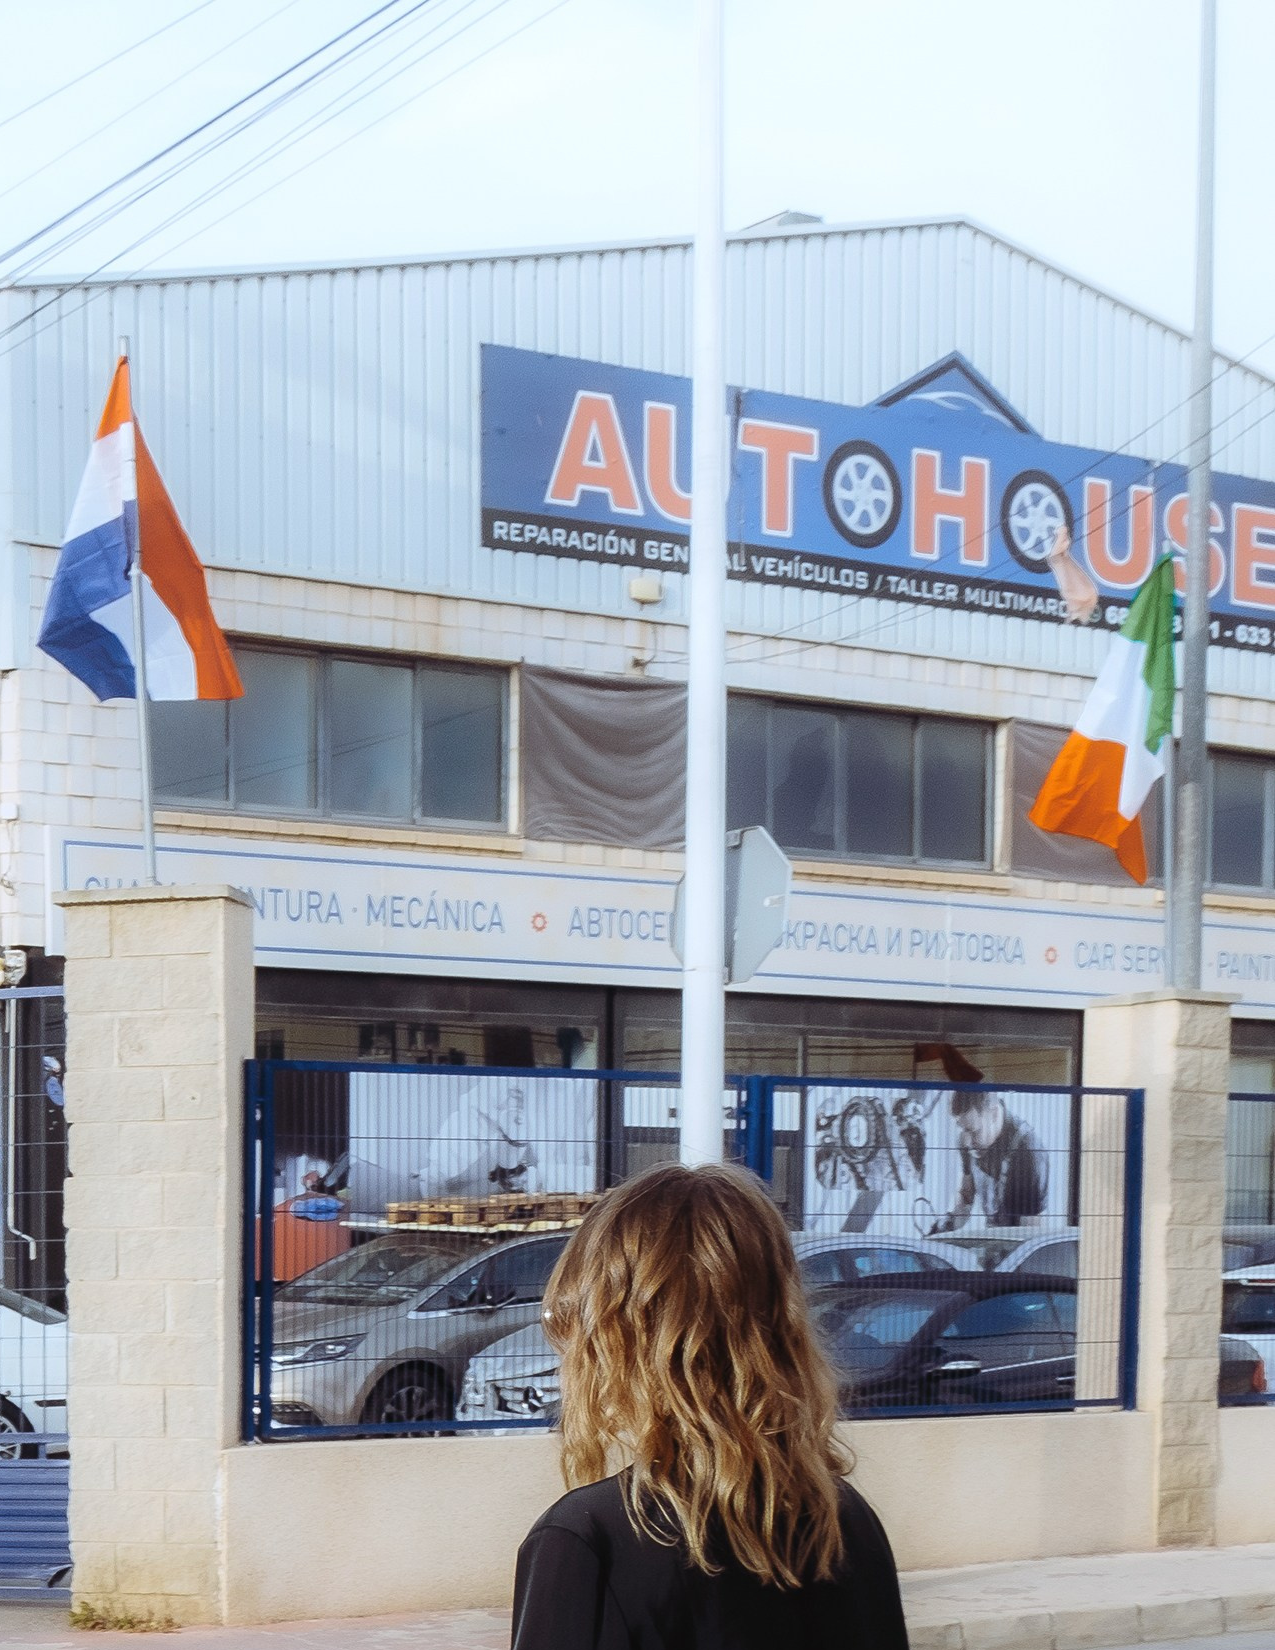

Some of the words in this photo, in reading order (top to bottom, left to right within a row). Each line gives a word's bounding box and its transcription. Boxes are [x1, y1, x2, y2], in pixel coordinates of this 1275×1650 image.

[492, 520, 637, 557] REPARACIÓN
[750, 555, 869, 590] VEHÍCULOS
[886, 575, 960, 602] TALLER
[964, 586, 1071, 618] MULTIMARC
[240, 886, 343, 925] NTURA
[366, 891, 505, 935] MECÁNICA
[1074, 941, 1115, 971] CAR
[1217, 950, 1275, 983] PAINT
